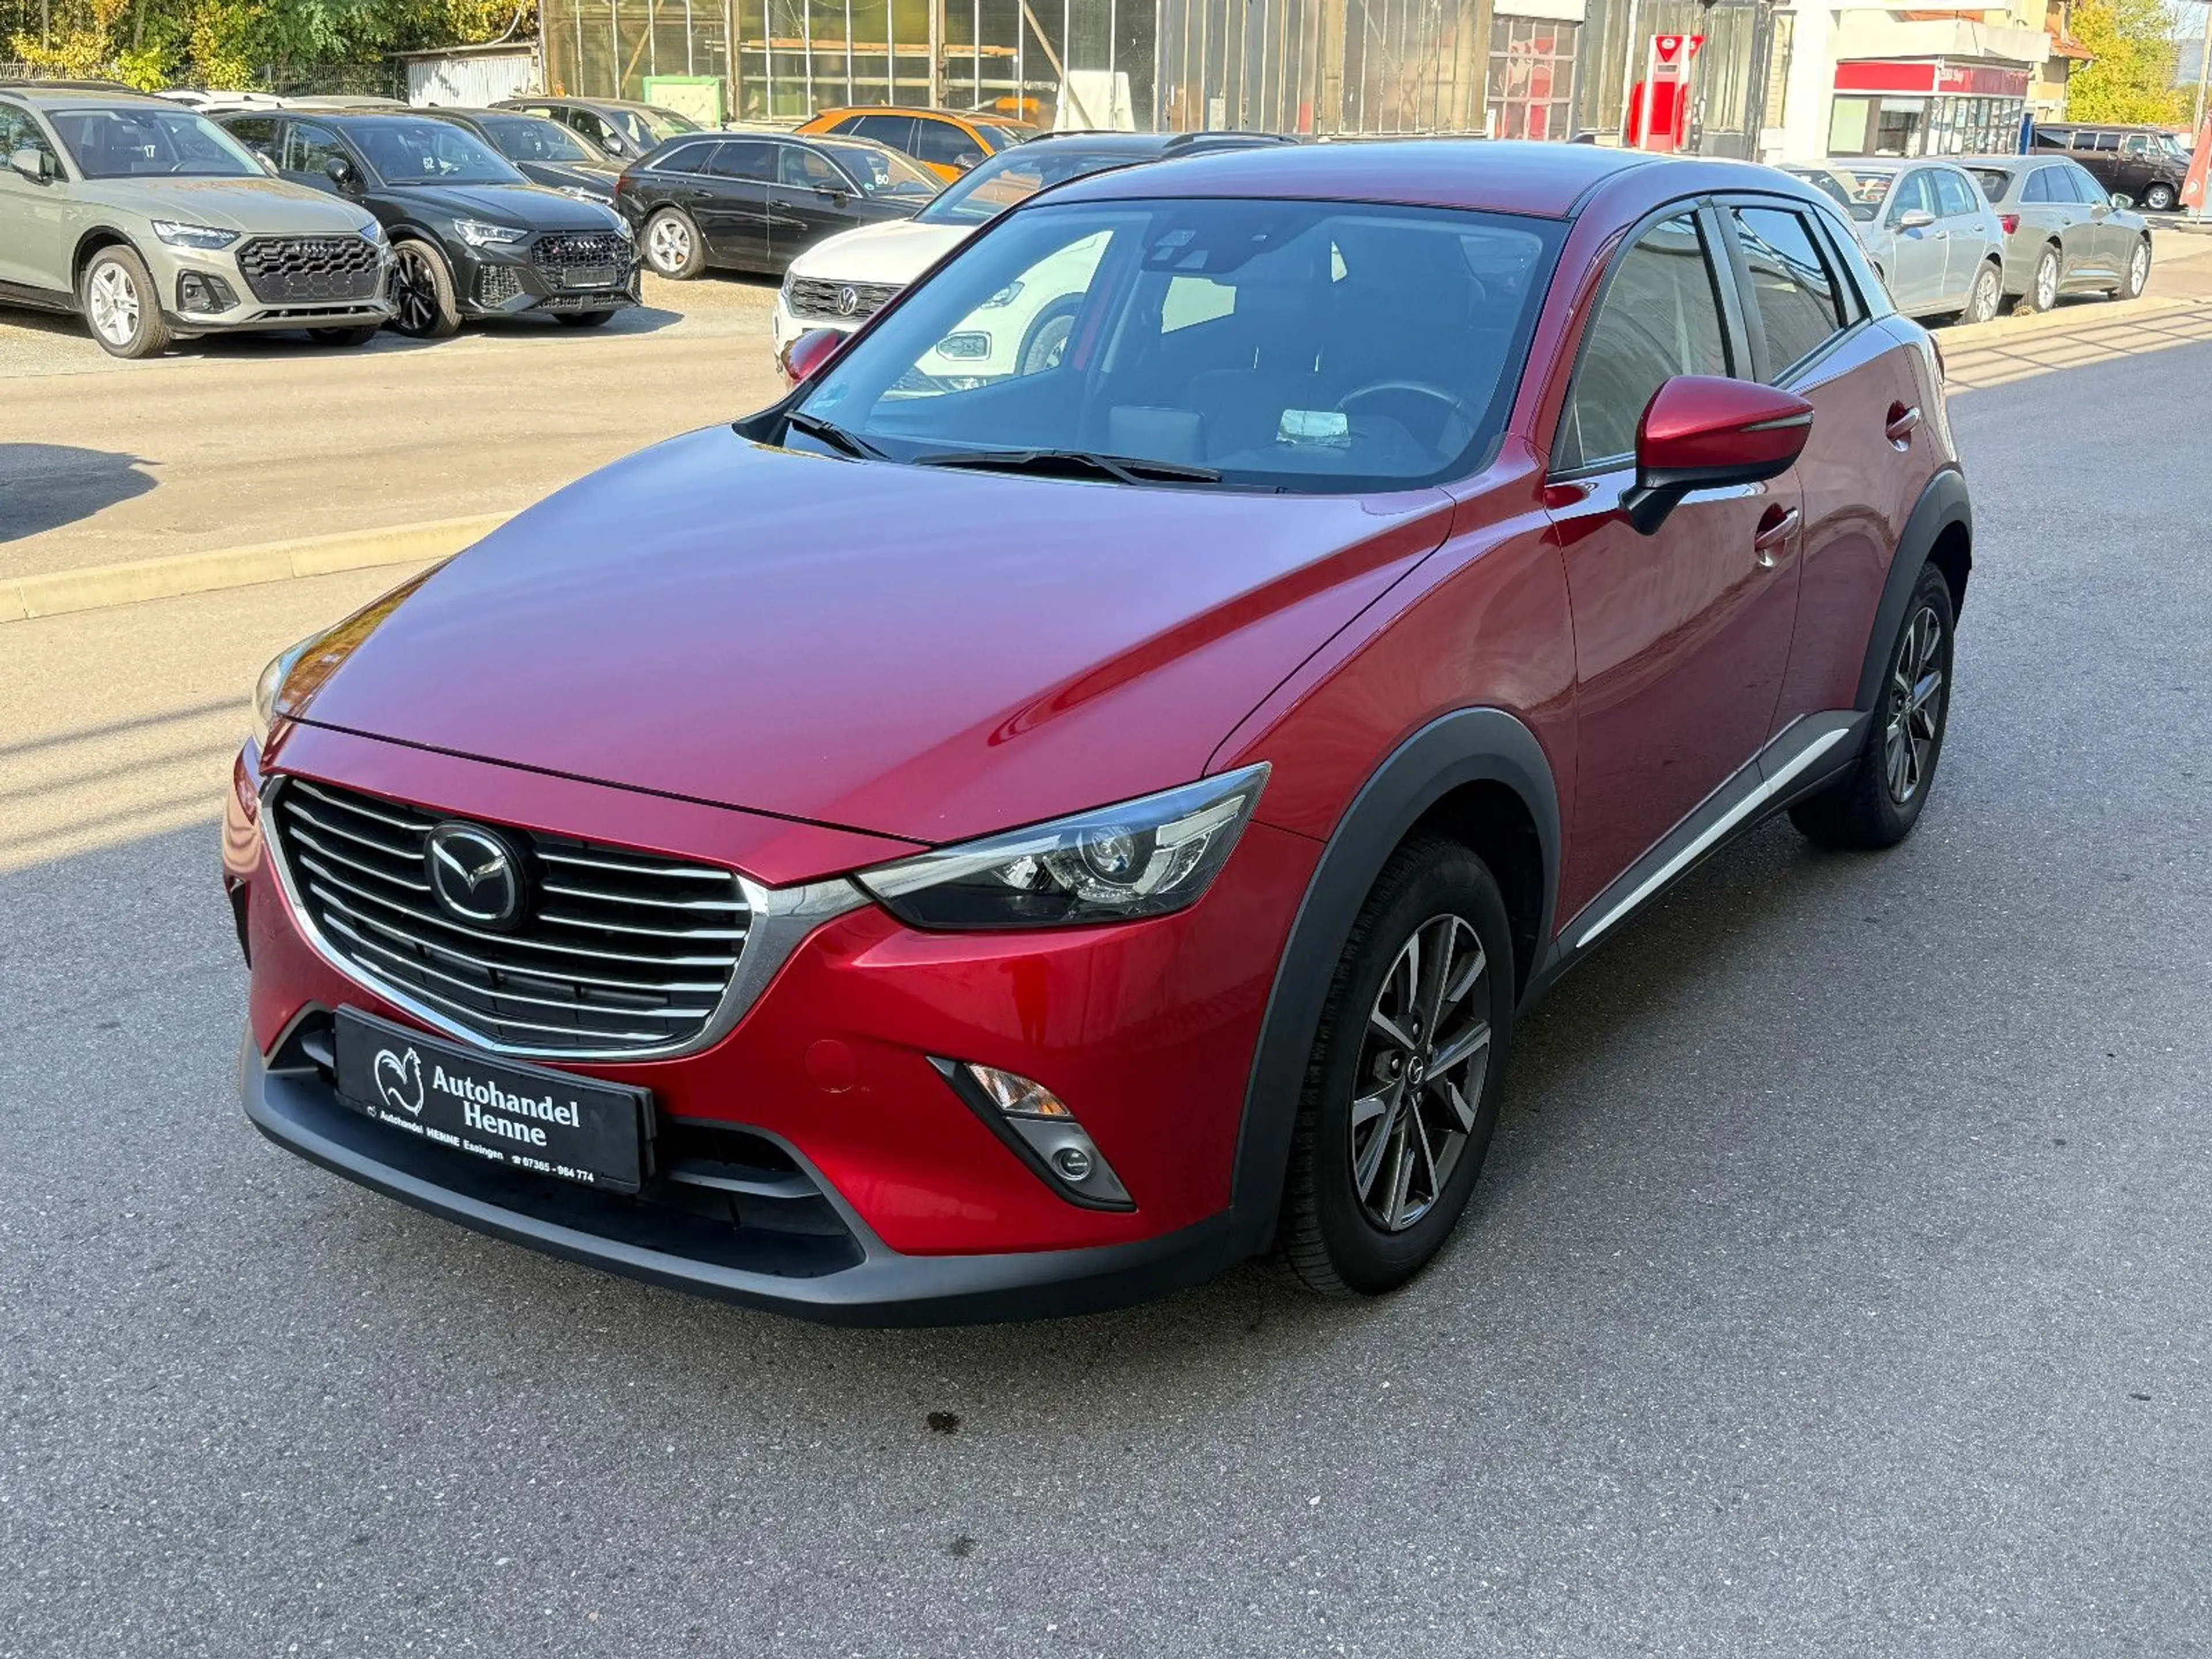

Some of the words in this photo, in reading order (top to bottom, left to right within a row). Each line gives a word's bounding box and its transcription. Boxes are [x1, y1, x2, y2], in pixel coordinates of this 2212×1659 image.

[433, 1066, 579, 1127] Autohandel
[463, 1100, 547, 1146] Henne
[380, 1110, 424, 1134] Autohandel
[426, 1127, 460, 1147] HENNE
[463, 1139, 504, 1160] Essingen
[576, 1169, 594, 1183] 774
